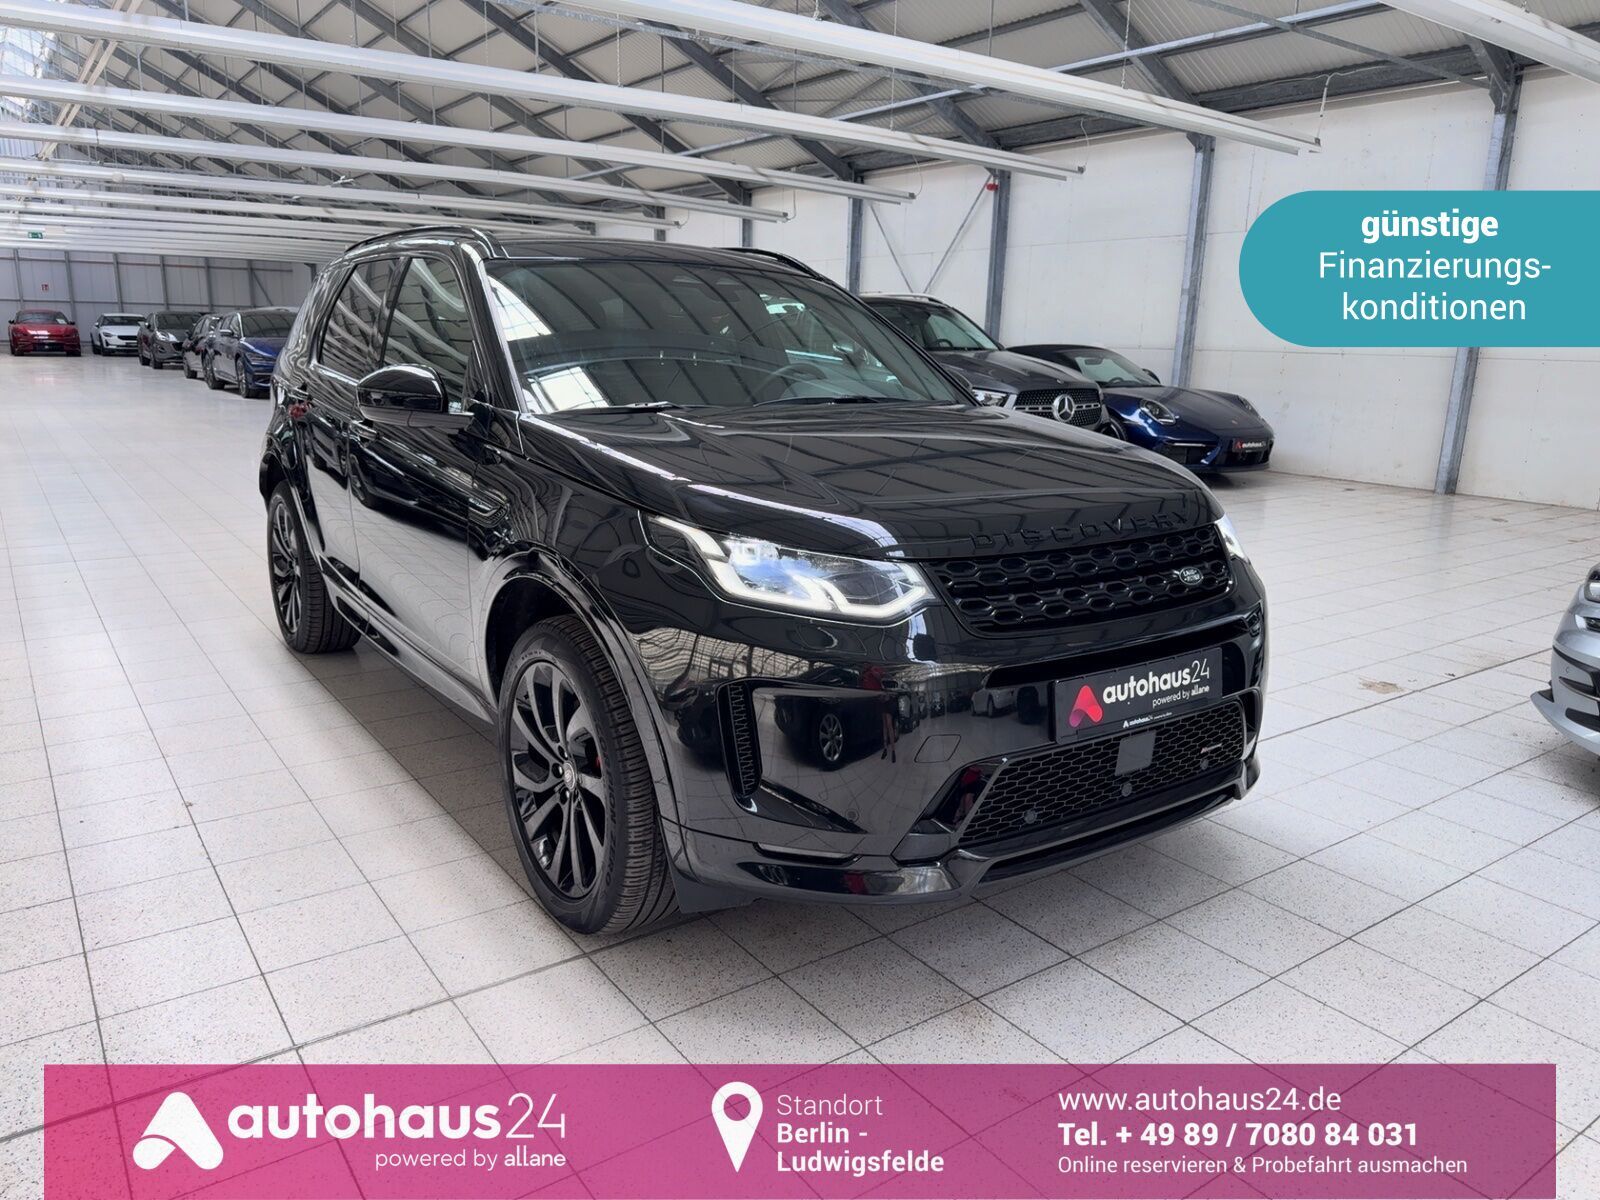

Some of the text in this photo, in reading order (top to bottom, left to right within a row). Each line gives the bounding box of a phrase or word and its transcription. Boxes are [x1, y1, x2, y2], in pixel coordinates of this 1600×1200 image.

[969, 511, 1189, 549] DISCOVERY
[1102, 657, 1210, 704] autohaus24
[1152, 684, 1210, 709] powered by allane
